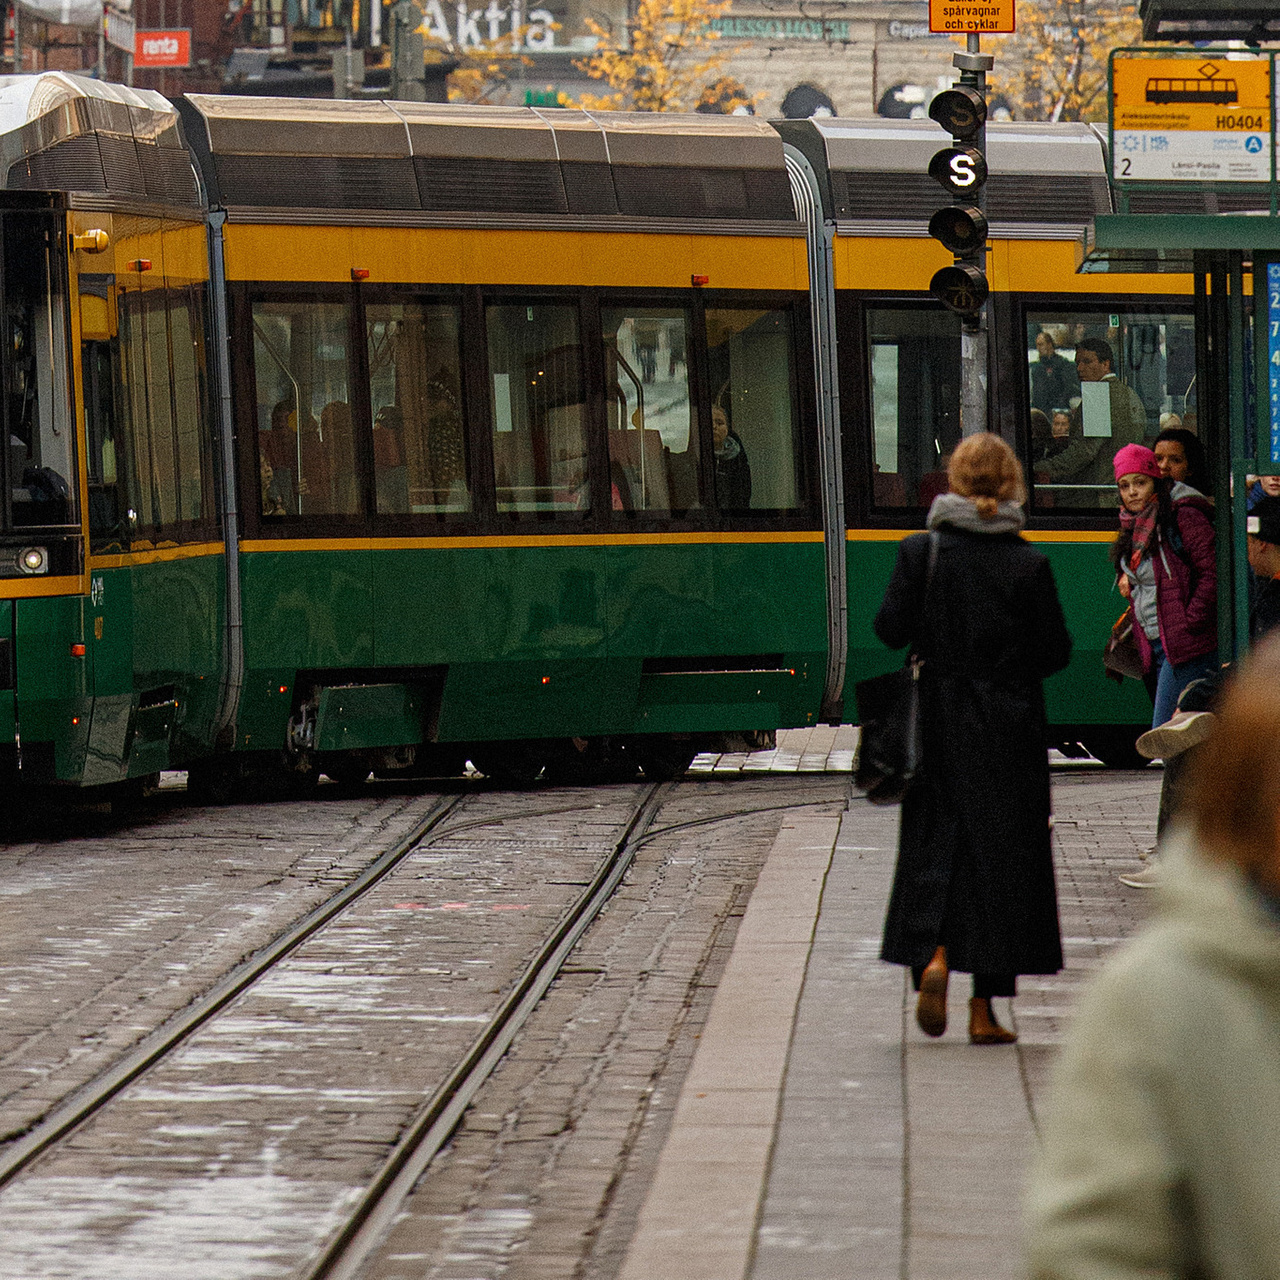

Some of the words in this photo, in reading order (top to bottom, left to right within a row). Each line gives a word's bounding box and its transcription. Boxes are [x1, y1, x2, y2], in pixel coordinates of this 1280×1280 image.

[943, 5, 1001, 17] spårvagnar
[945, 19, 964, 29] och
[967, 19, 999, 31] cyklar
[1216, 114, 1263, 130] H0404
[949, 154, 976, 187] S
[1121, 157, 1132, 176] 2
